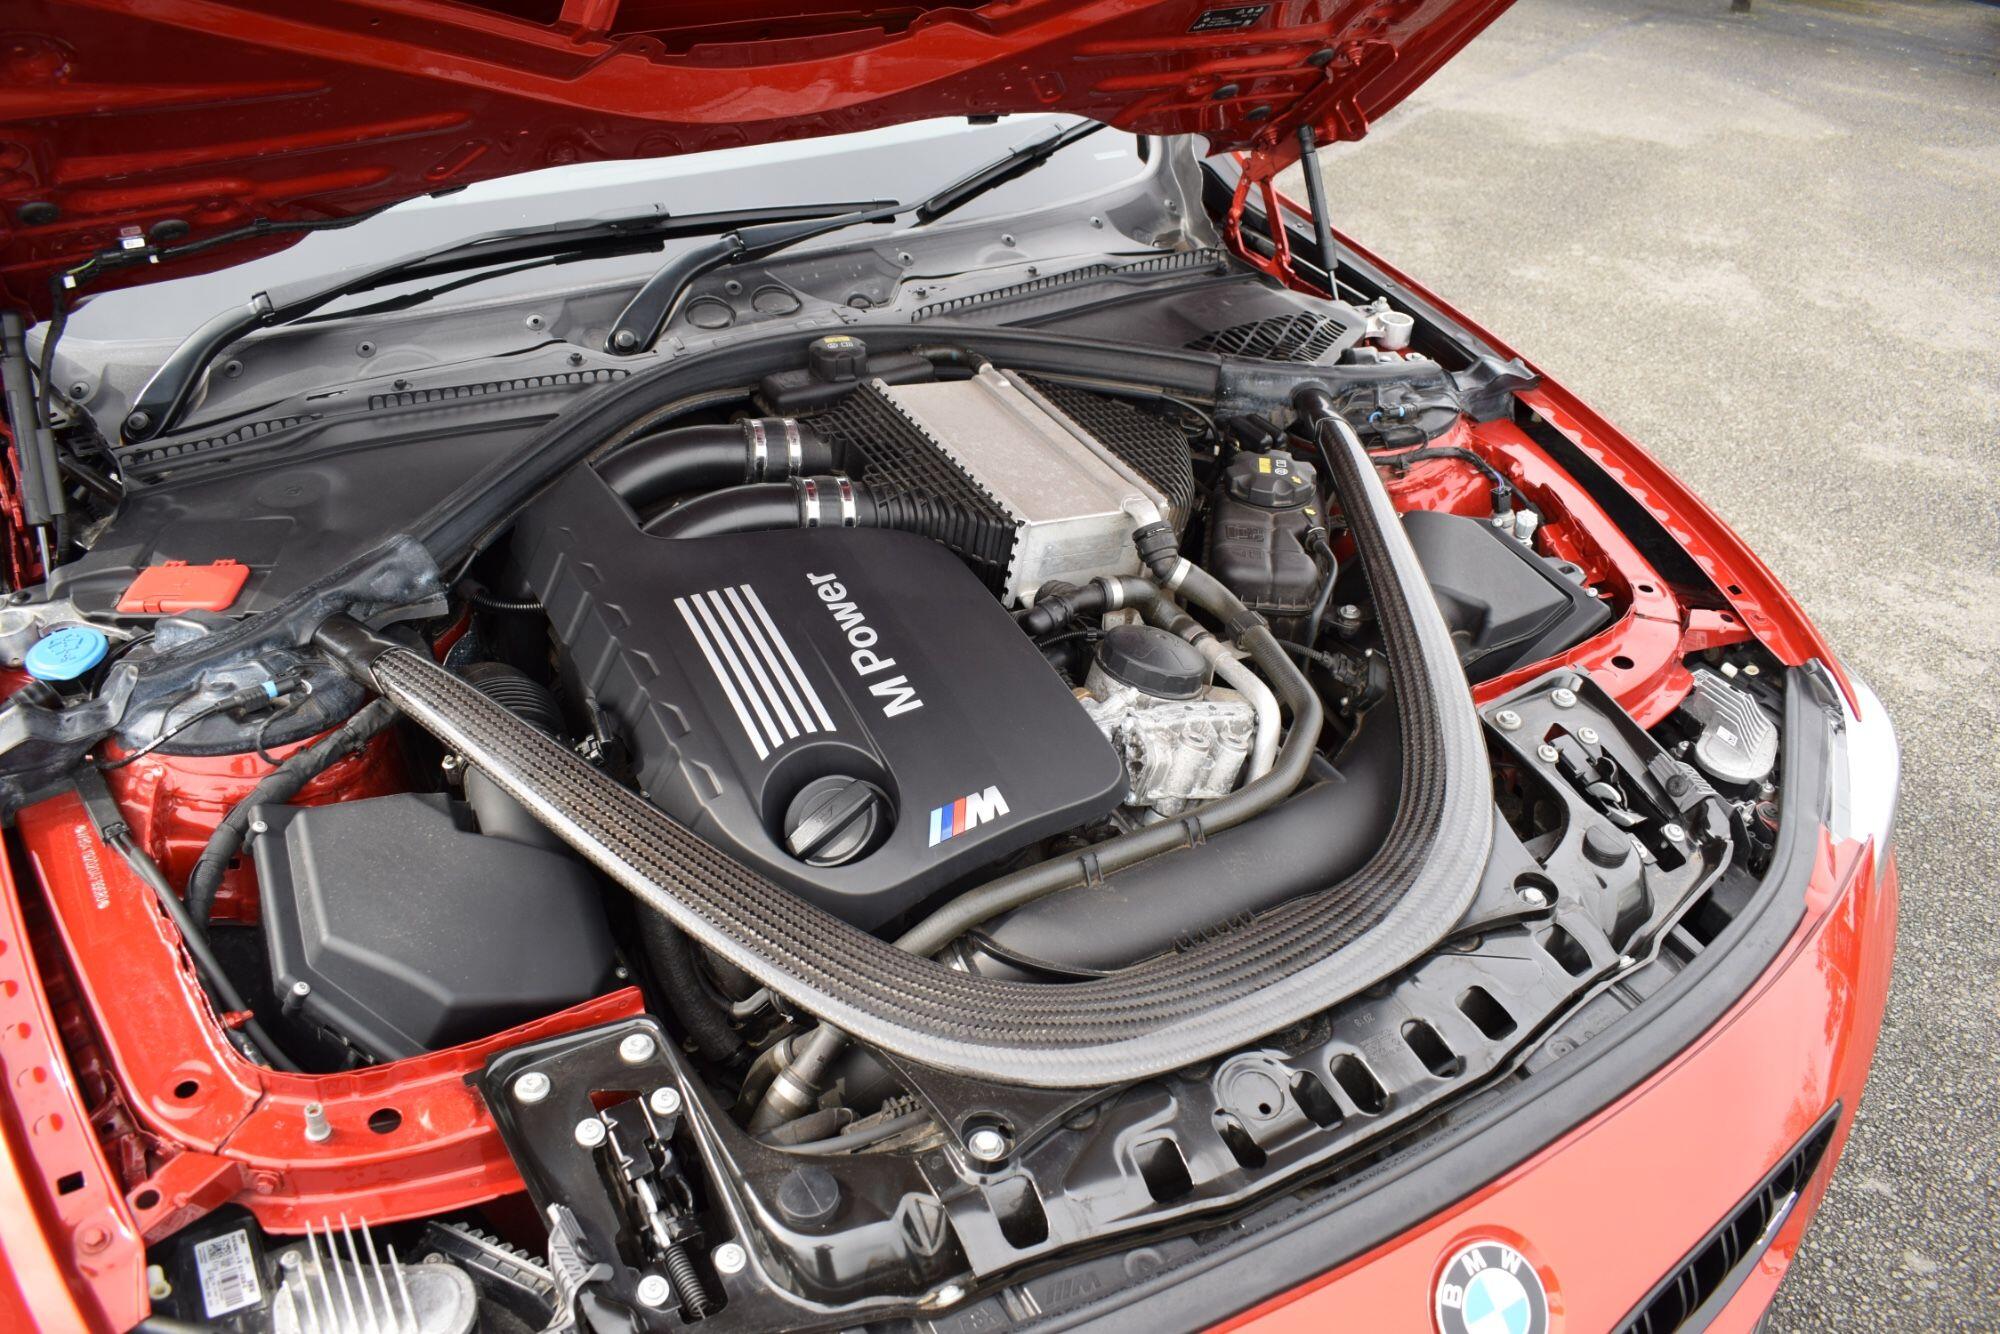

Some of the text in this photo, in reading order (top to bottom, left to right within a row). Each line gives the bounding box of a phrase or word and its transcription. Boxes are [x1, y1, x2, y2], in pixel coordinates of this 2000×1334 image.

[806, 572, 924, 718] M Power
[1441, 1247, 1522, 1310] BMW
